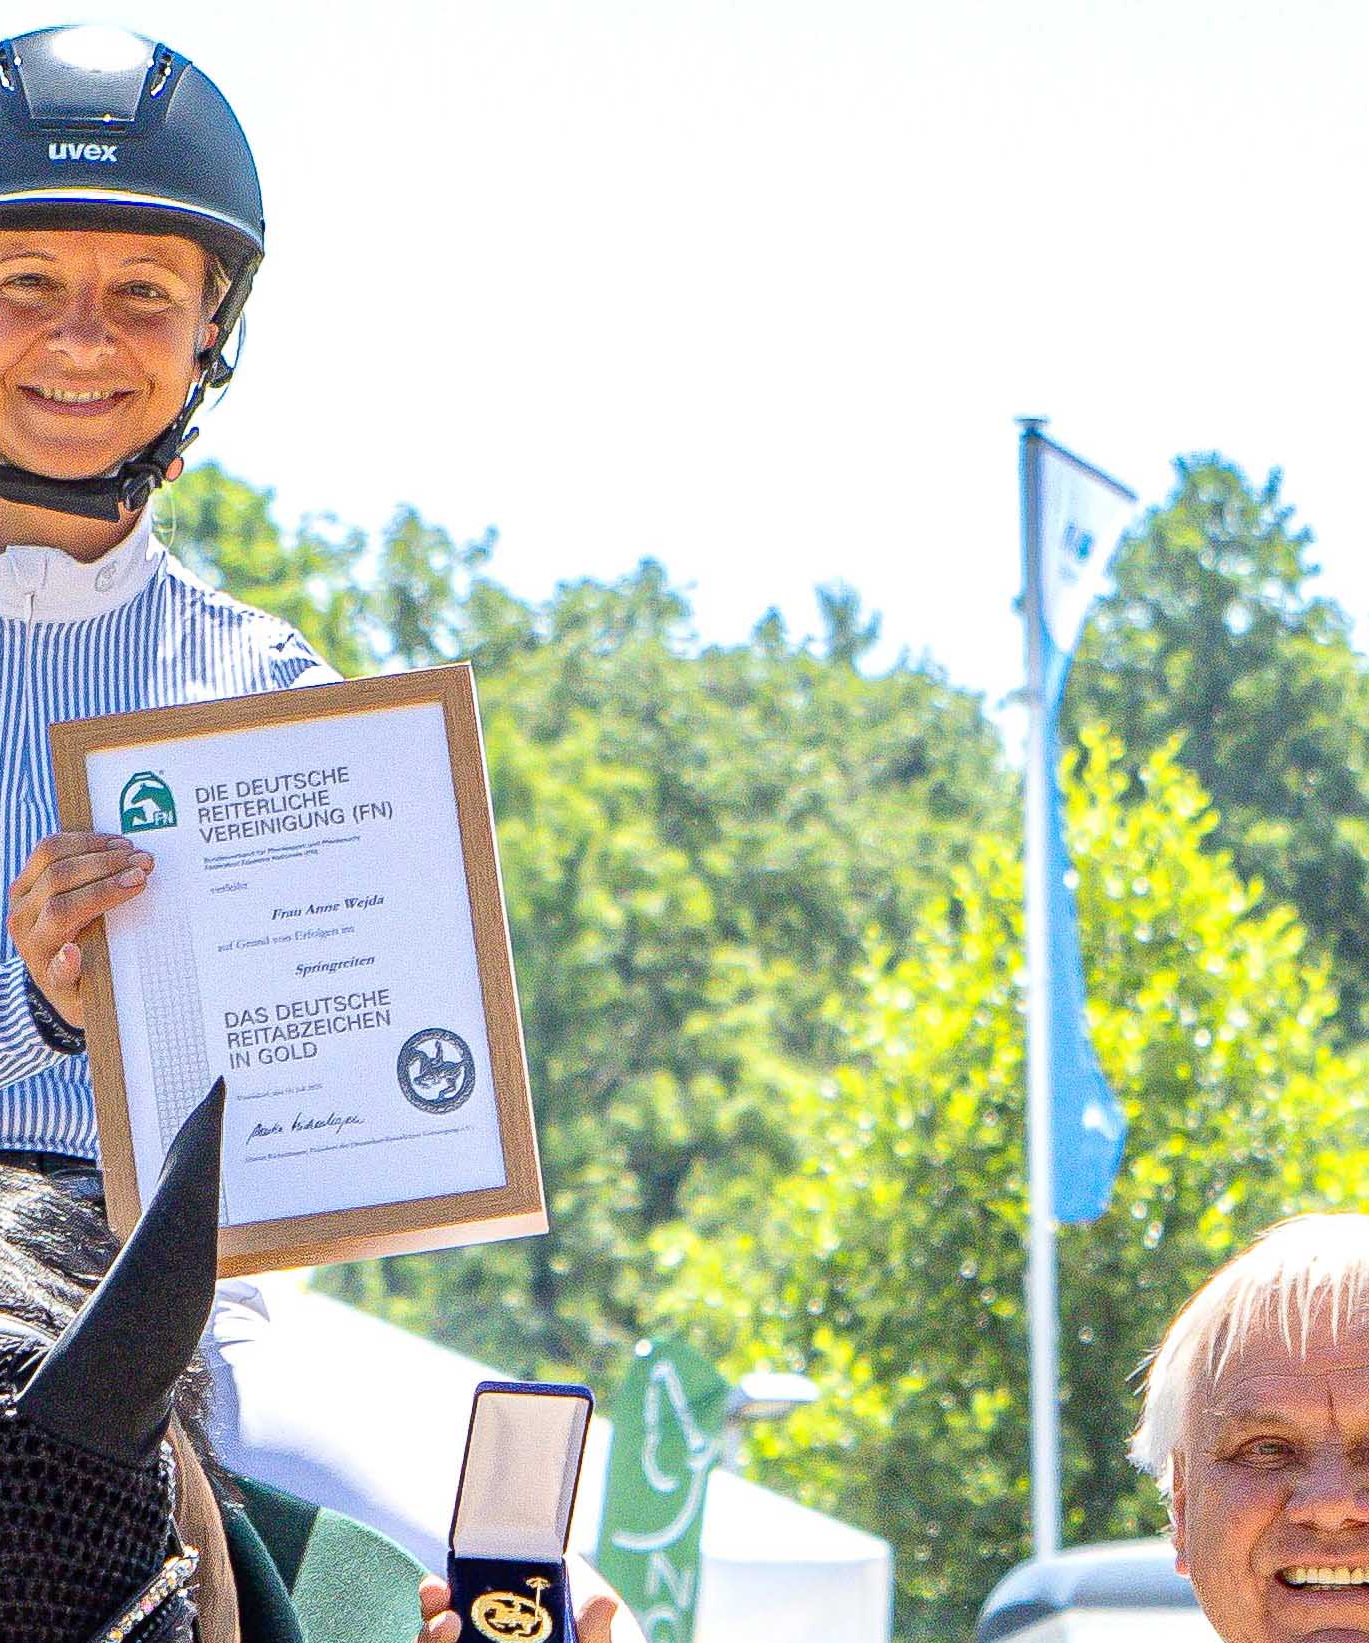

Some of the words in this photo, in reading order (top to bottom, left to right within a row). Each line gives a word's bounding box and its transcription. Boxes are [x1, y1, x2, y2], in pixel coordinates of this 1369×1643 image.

[48, 141, 118, 162] uvex
[195, 784, 229, 804] DIE
[236, 766, 350, 798] DEUTSCHE
[198, 790, 330, 824] REITERLICHE
[199, 808, 345, 844] VEREINIGUNG
[351, 801, 393, 825] (FN)
[271, 908, 302, 920] Frau
[305, 902, 340, 915] Anne
[344, 894, 384, 910] Wejda
[295, 956, 375, 978] Springreiten
[224, 1006, 269, 1028] DAS
[276, 988, 391, 1021] DEUTSCHE
[227, 1009, 391, 1048] REITABZEICHEN
[229, 1050, 251, 1070] IN
[257, 1041, 318, 1065] GOLD
